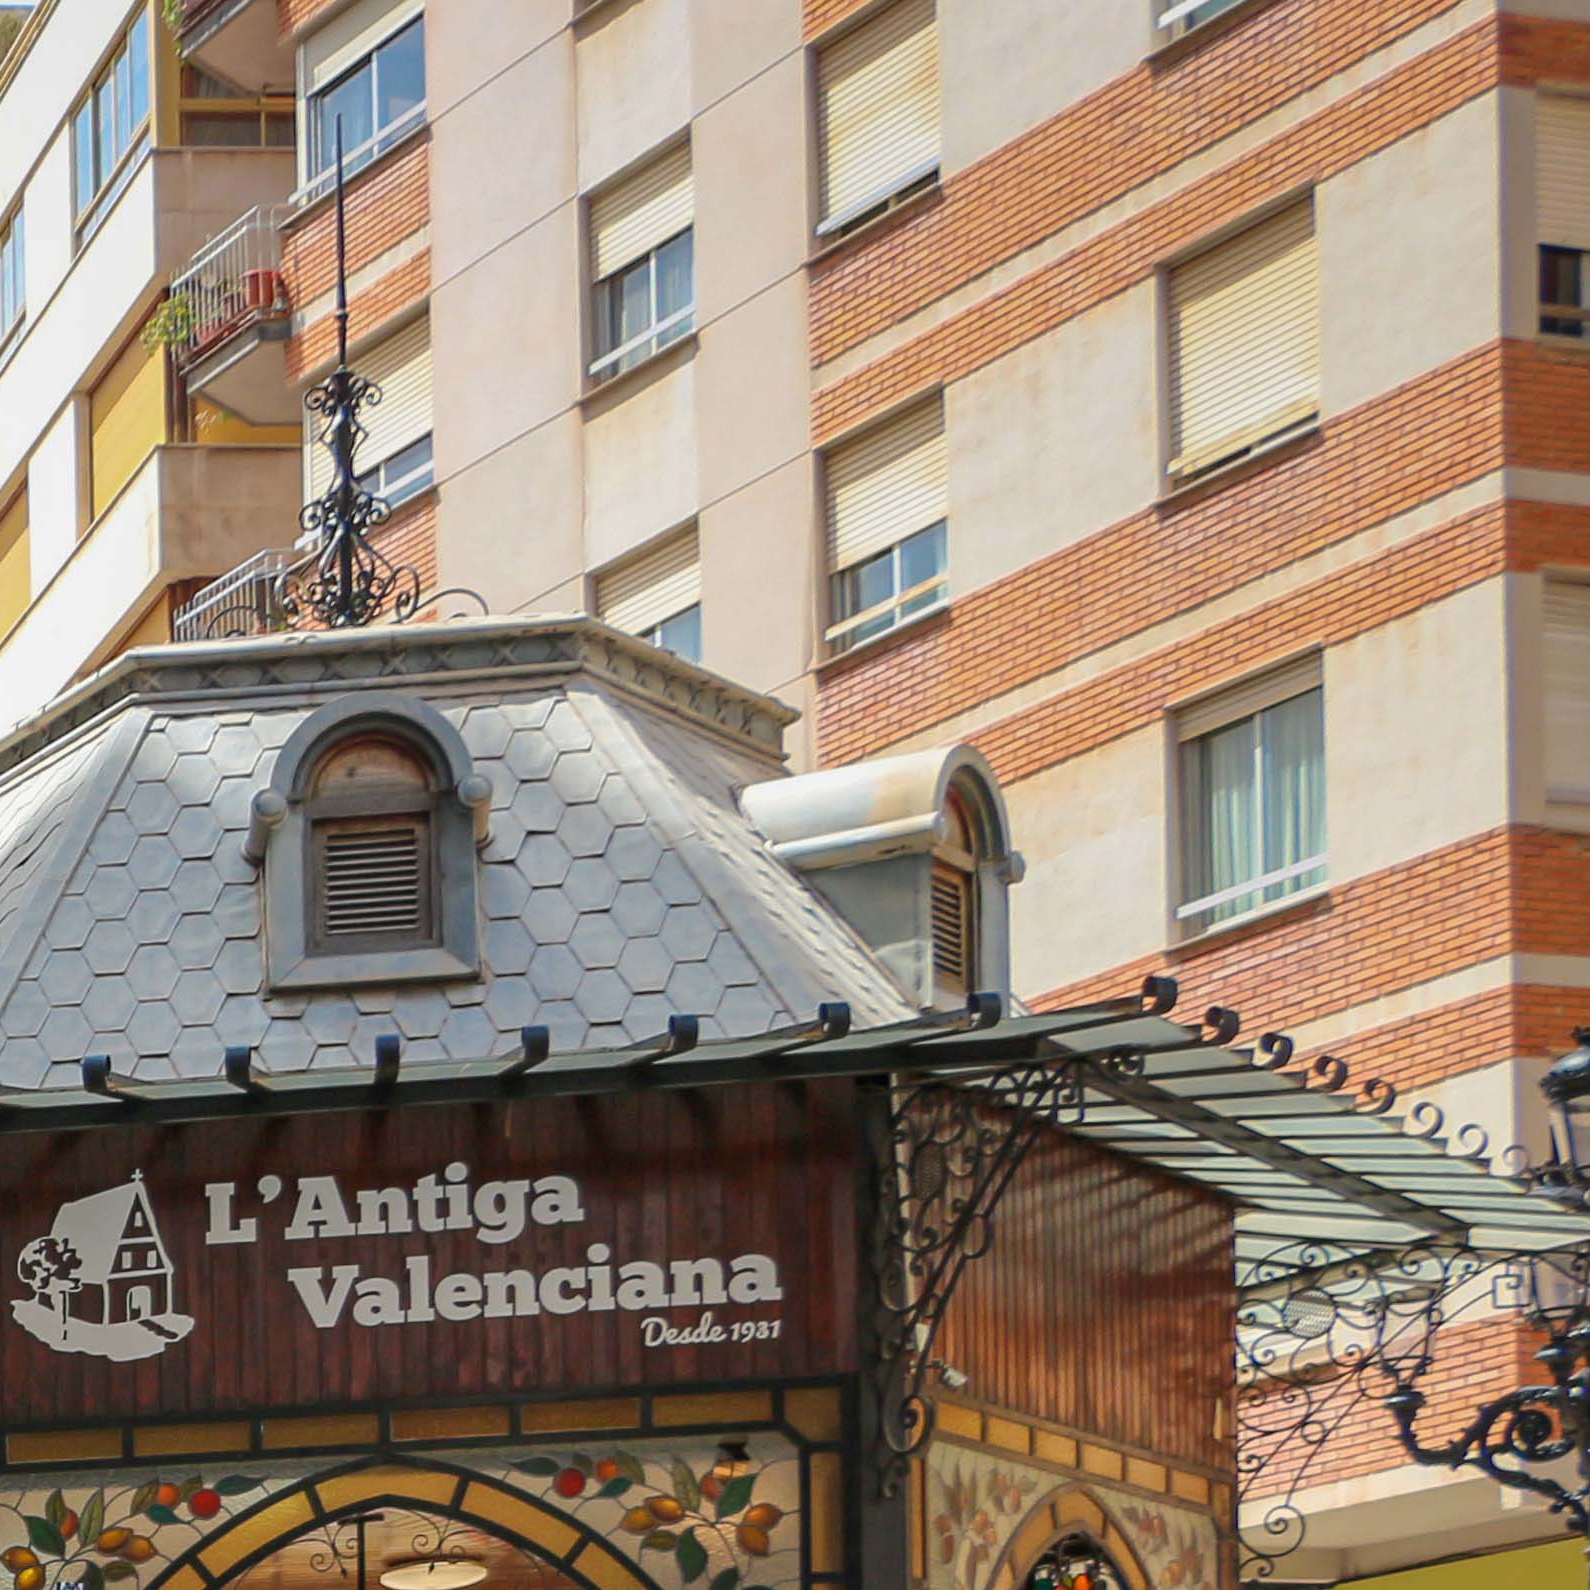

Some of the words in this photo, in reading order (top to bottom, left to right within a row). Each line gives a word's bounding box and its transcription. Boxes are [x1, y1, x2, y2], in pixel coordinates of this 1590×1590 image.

[203, 1160, 585, 1246] L'Antiga
[286, 1242, 785, 1330] Valenciana
[640, 1312, 727, 1347] Desde
[730, 1318, 781, 1345] 1931
